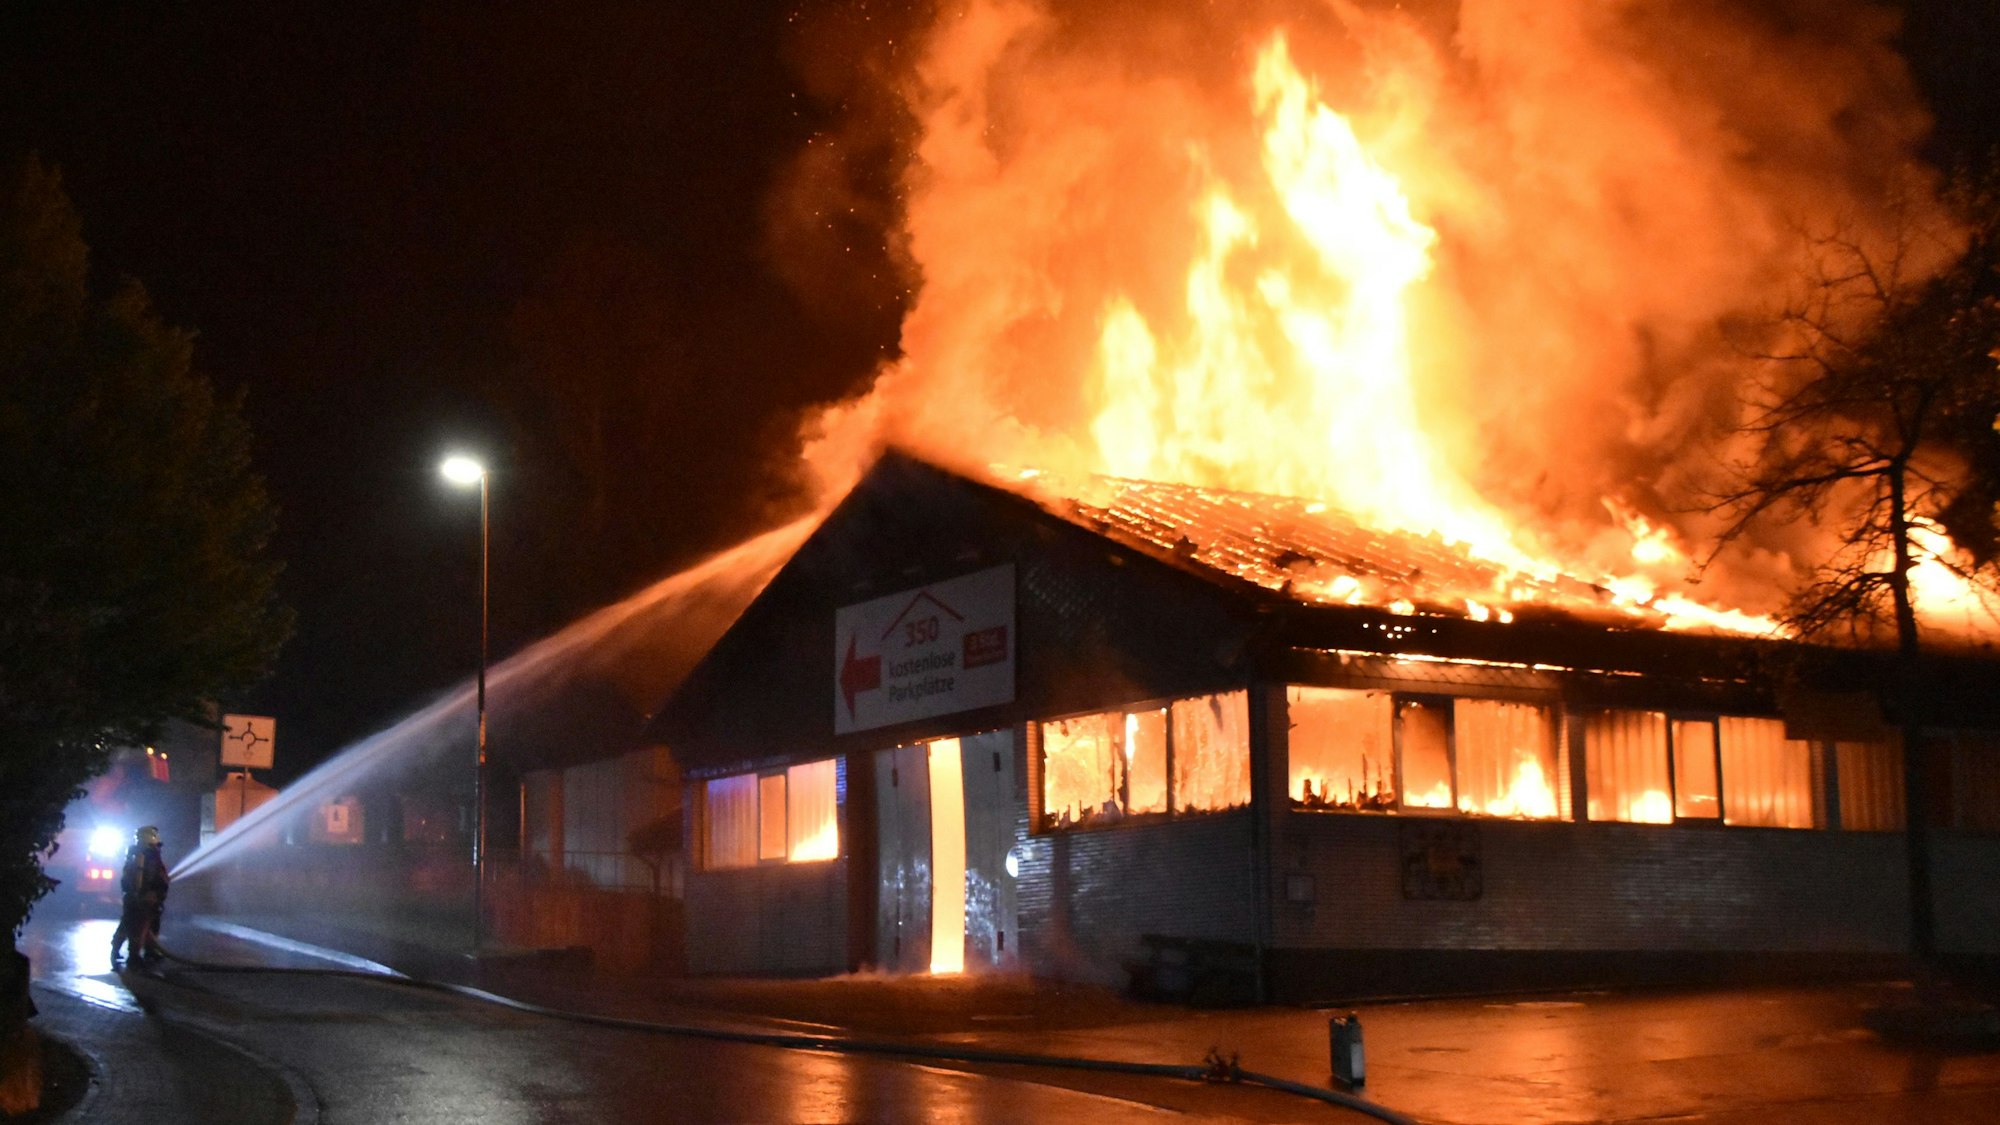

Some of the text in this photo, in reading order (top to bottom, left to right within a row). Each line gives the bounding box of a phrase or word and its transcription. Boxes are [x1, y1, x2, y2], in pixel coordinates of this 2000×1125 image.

[905, 616, 940, 648] 350
[889, 652, 956, 678] kostenlose
[889, 675, 955, 702] Parkplätze
